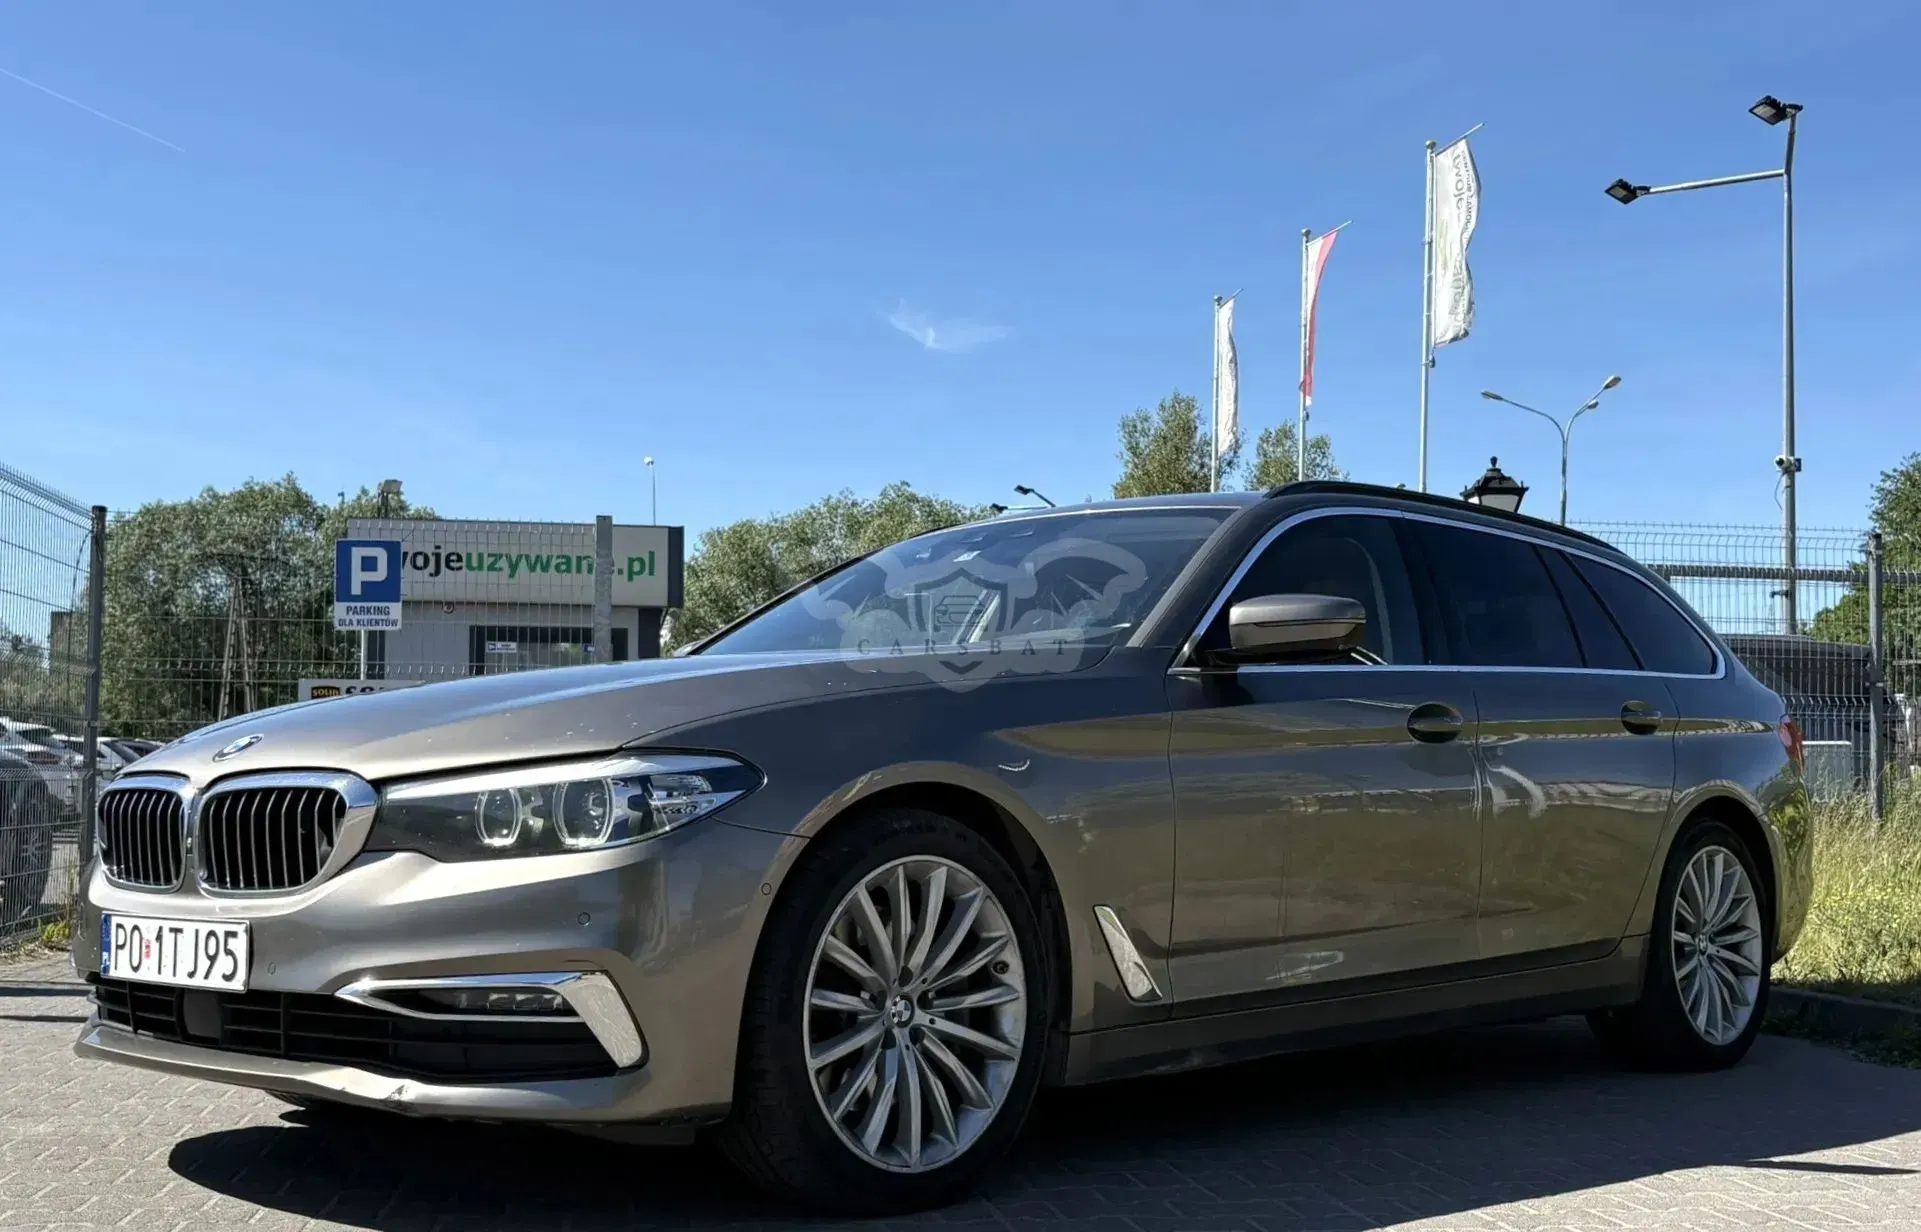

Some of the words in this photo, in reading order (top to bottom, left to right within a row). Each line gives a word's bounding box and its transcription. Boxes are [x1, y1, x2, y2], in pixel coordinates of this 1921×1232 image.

[350, 546, 388, 595] P
[402, 545, 656, 582] ojeuzywan.pl
[338, 618, 354, 627] DLA
[356, 617, 399, 627] KLIENTÓW
[346, 605, 390, 616] PARKING
[312, 687, 340, 697] SOLID
[114, 922, 143, 973] PO
[155, 926, 238, 982] 1TJ95
